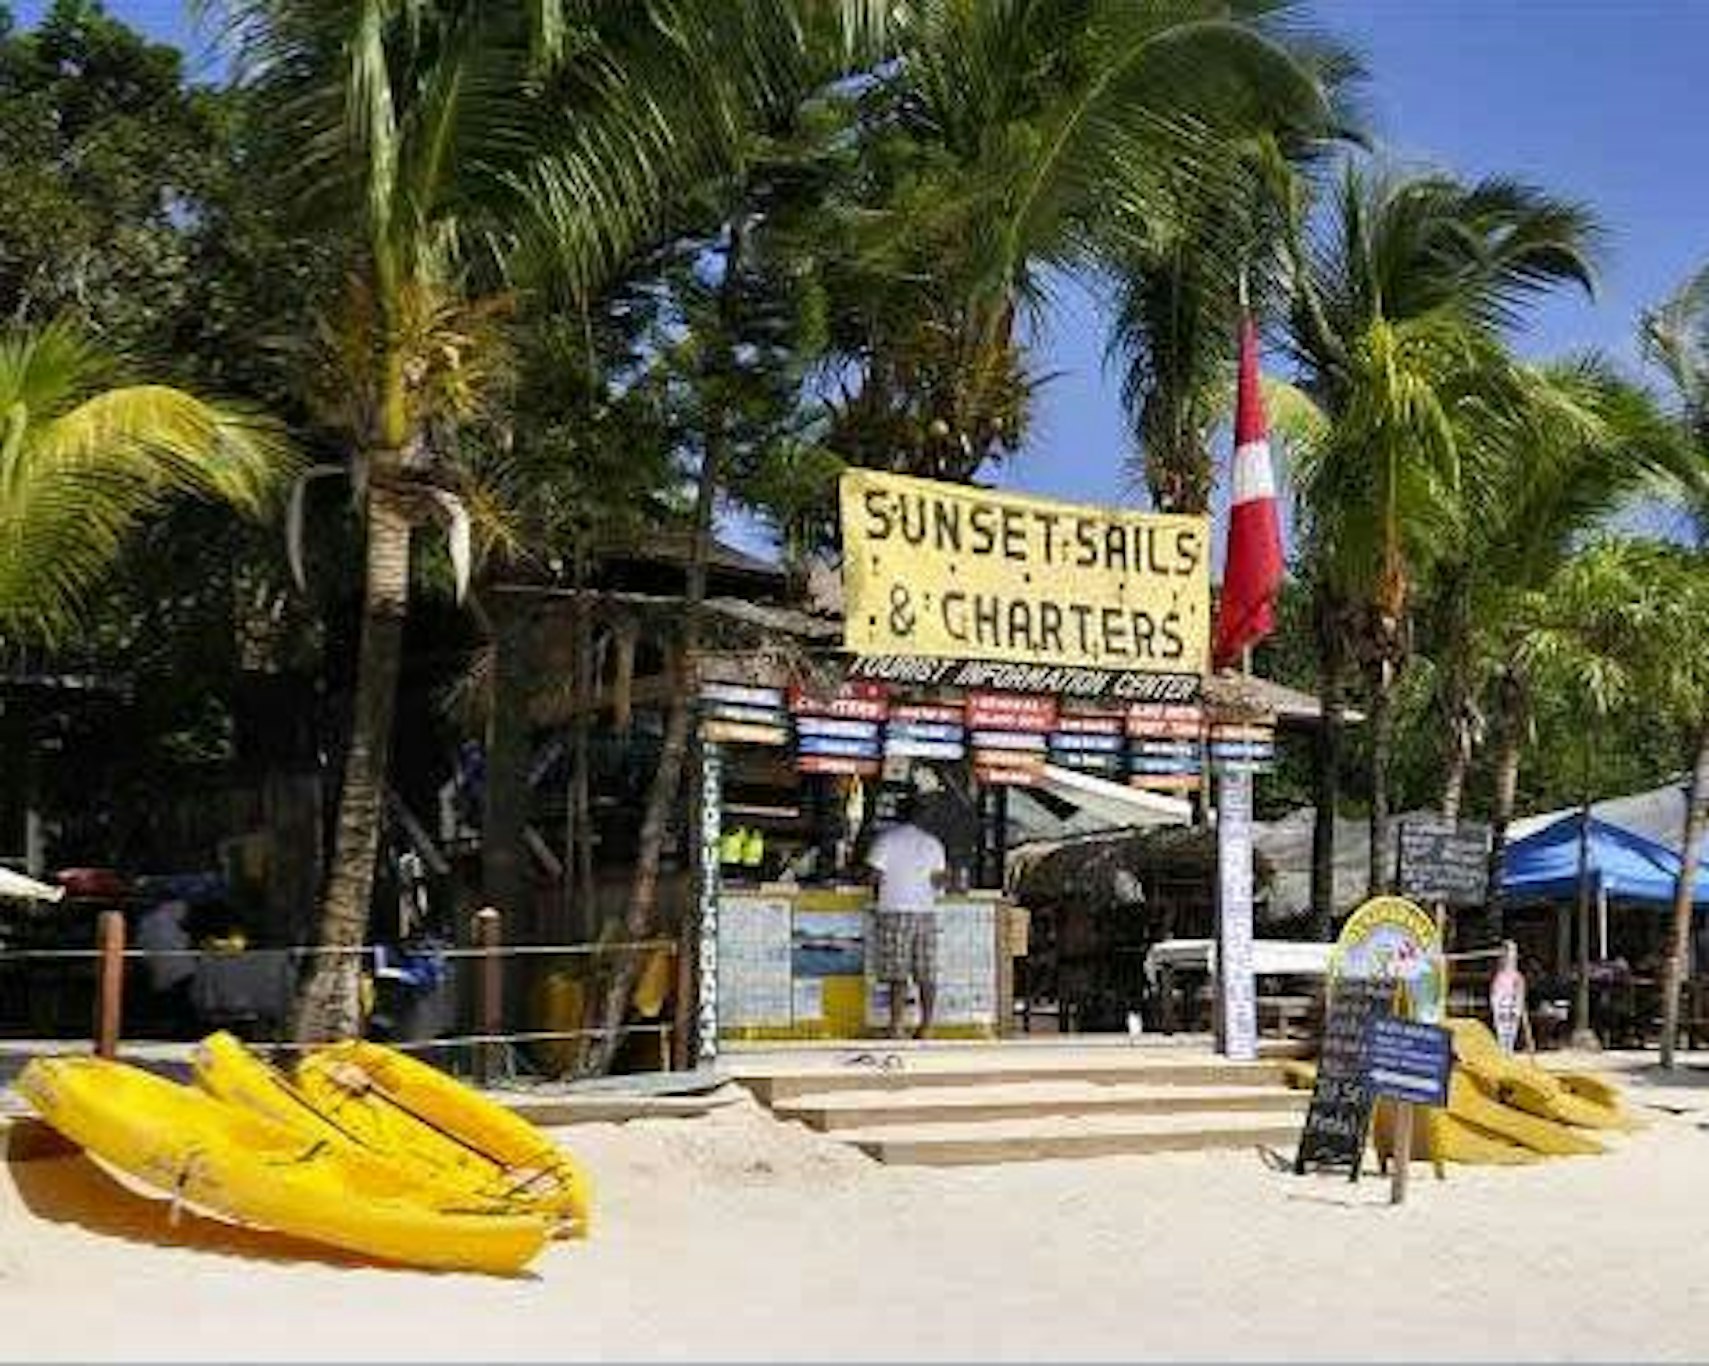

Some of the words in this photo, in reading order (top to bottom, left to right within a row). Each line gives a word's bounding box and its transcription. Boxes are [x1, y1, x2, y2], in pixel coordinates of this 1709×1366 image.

[864, 489, 1059, 561] SUNSET
[1075, 516, 1198, 577] SAILS
[888, 582, 916, 637] &
[940, 590, 1185, 660] CHARTERS
[849, 654, 957, 684] TOURIST
[954, 659, 1112, 696] INFORMATION
[1113, 671, 1200, 701] CENTER
